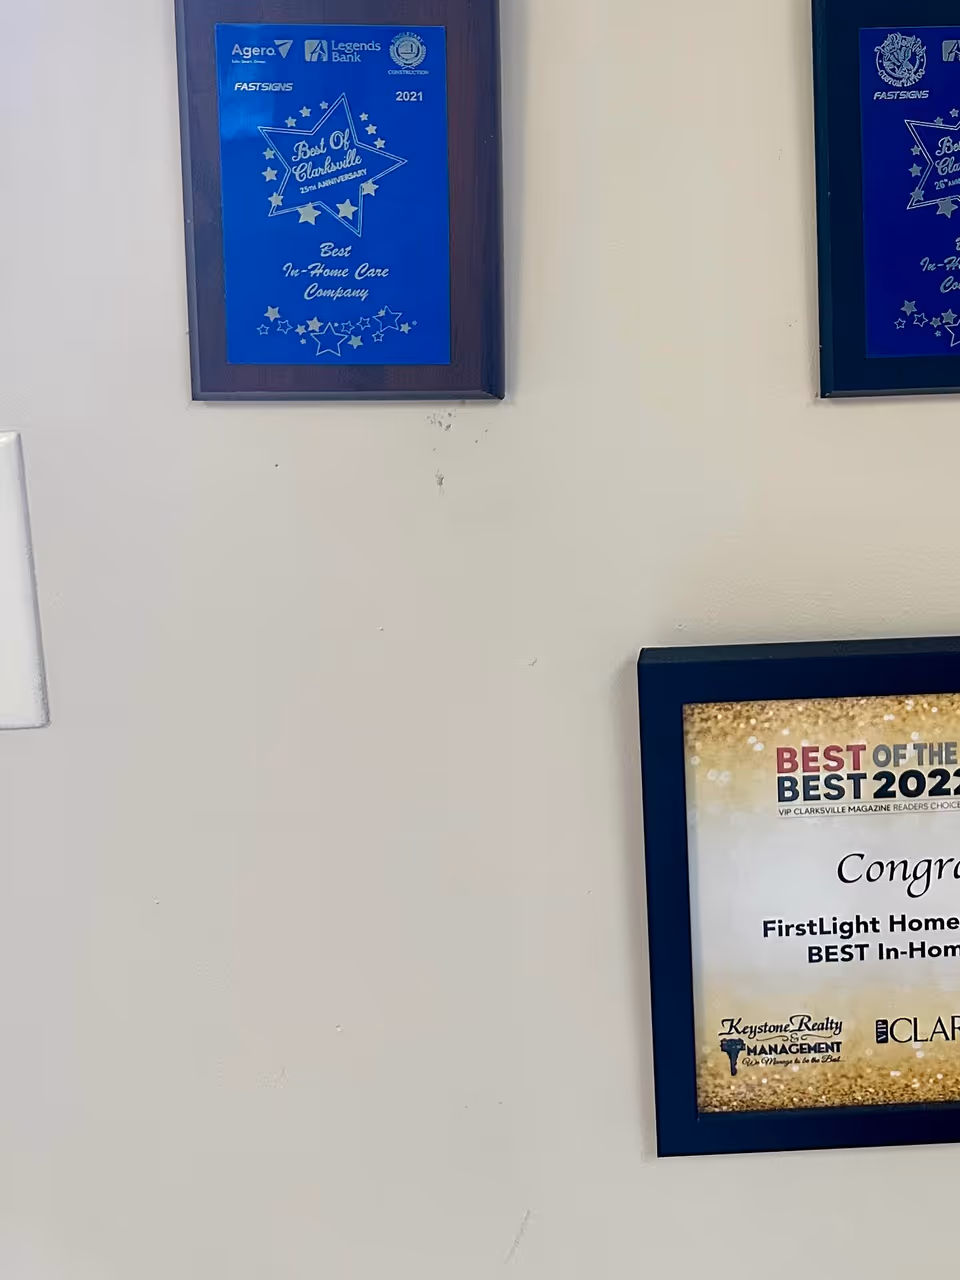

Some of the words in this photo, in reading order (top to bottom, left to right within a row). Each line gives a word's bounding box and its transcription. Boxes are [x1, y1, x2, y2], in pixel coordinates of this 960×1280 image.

[232, 44, 275, 59] Agero
[332, 40, 381, 52] Legends
[332, 51, 361, 62] Bank
[234, 82, 293, 92] FASTSIGNS
[873, 90, 929, 100] FASTSIGNS
[395, 91, 423, 102] 2021
[291, 138, 327, 162] Best
[329, 129, 350, 150] Of
[292, 148, 362, 182] Clarksville
[320, 242, 352, 257] Best
[282, 263, 349, 278] In-Home
[354, 263, 389, 280] Care
[304, 283, 369, 301] Company
[777, 744, 866, 773] BEST
[872, 744, 907, 767] OF
[913, 742, 957, 765] THE
[777, 773, 867, 802] BEST
[779, 808, 791, 816] VIP
[793, 806, 846, 815] CLARKSVILLE
[848, 804, 891, 813] MAGAZINE
[893, 802, 928, 811] READERS
[930, 801, 960, 809] CHOICE
[762, 916, 880, 939] FirstLight
[889, 913, 960, 932] Home
[807, 943, 869, 963] BEST
[718, 1018, 790, 1039] Keystone
[789, 1015, 843, 1035] Realty
[876, 1020, 888, 1042] VIP
[789, 1033, 799, 1042] &
[747, 1042, 842, 1056] MANAGEMENT
